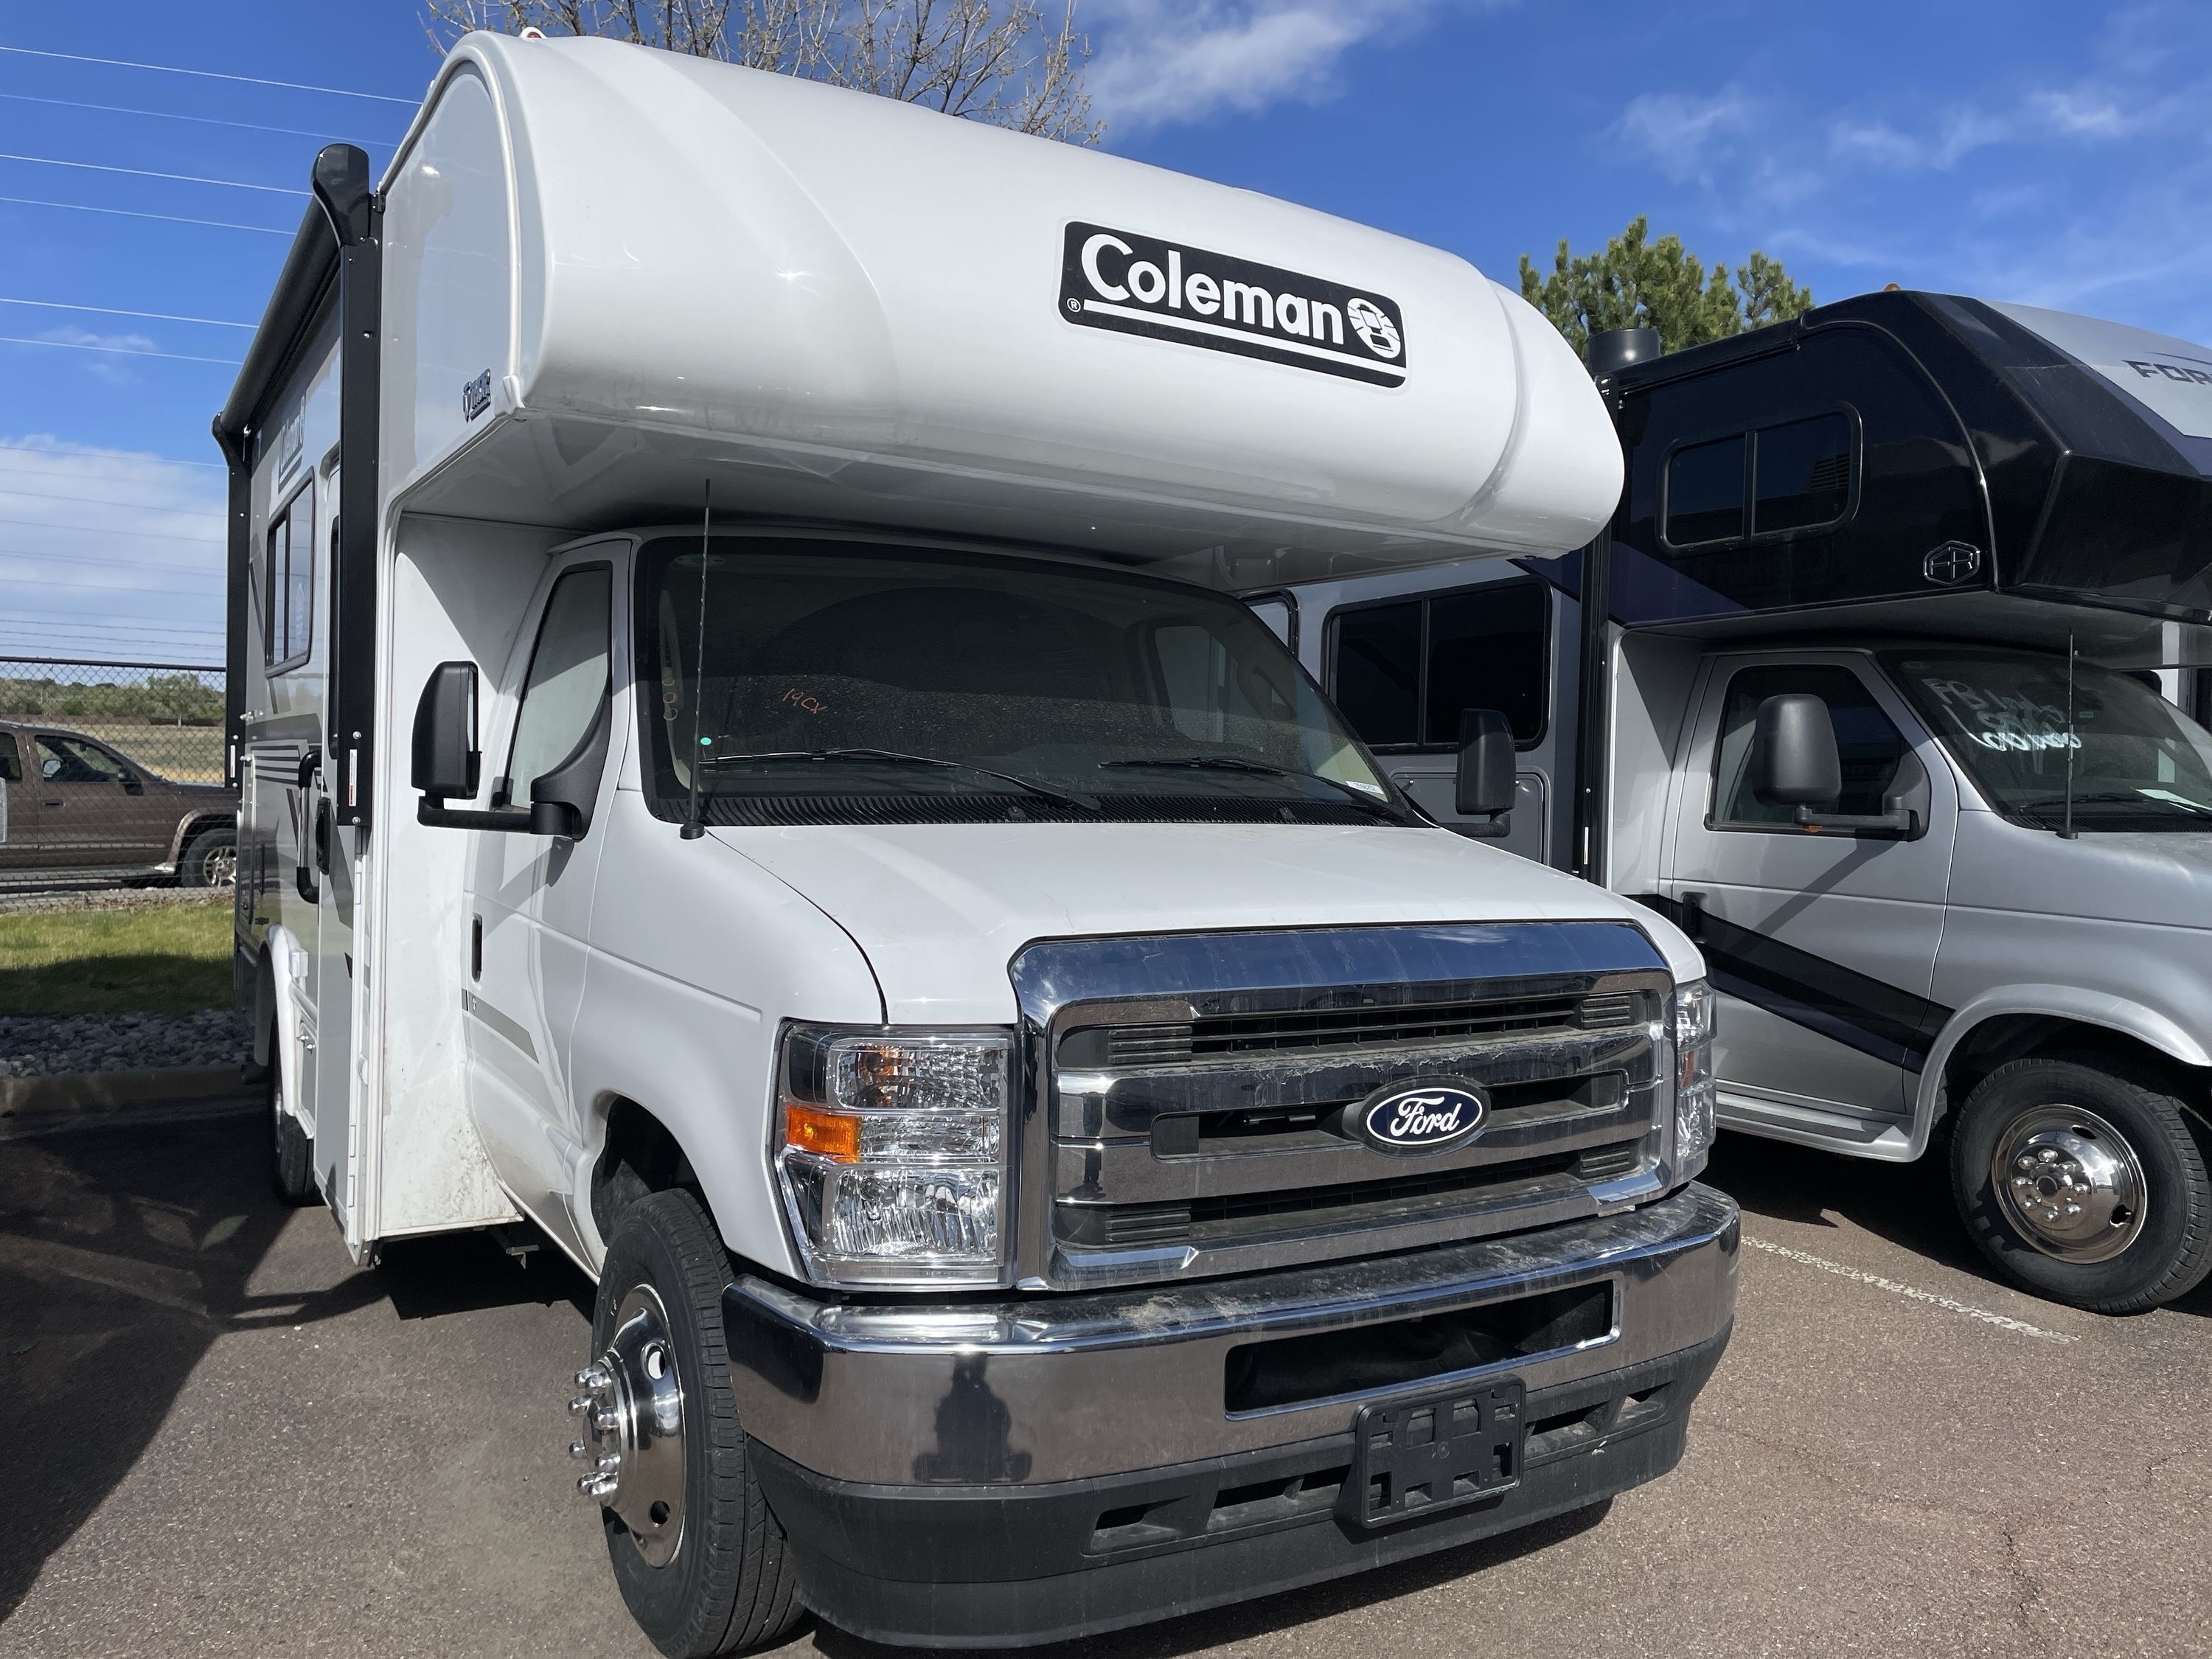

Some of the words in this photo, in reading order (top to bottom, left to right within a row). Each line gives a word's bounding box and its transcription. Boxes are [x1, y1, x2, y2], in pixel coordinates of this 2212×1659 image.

[1081, 233, 1344, 345] Coleman
[2121, 359, 2212, 385] FOR
[1390, 1096, 1462, 1137] Ford
